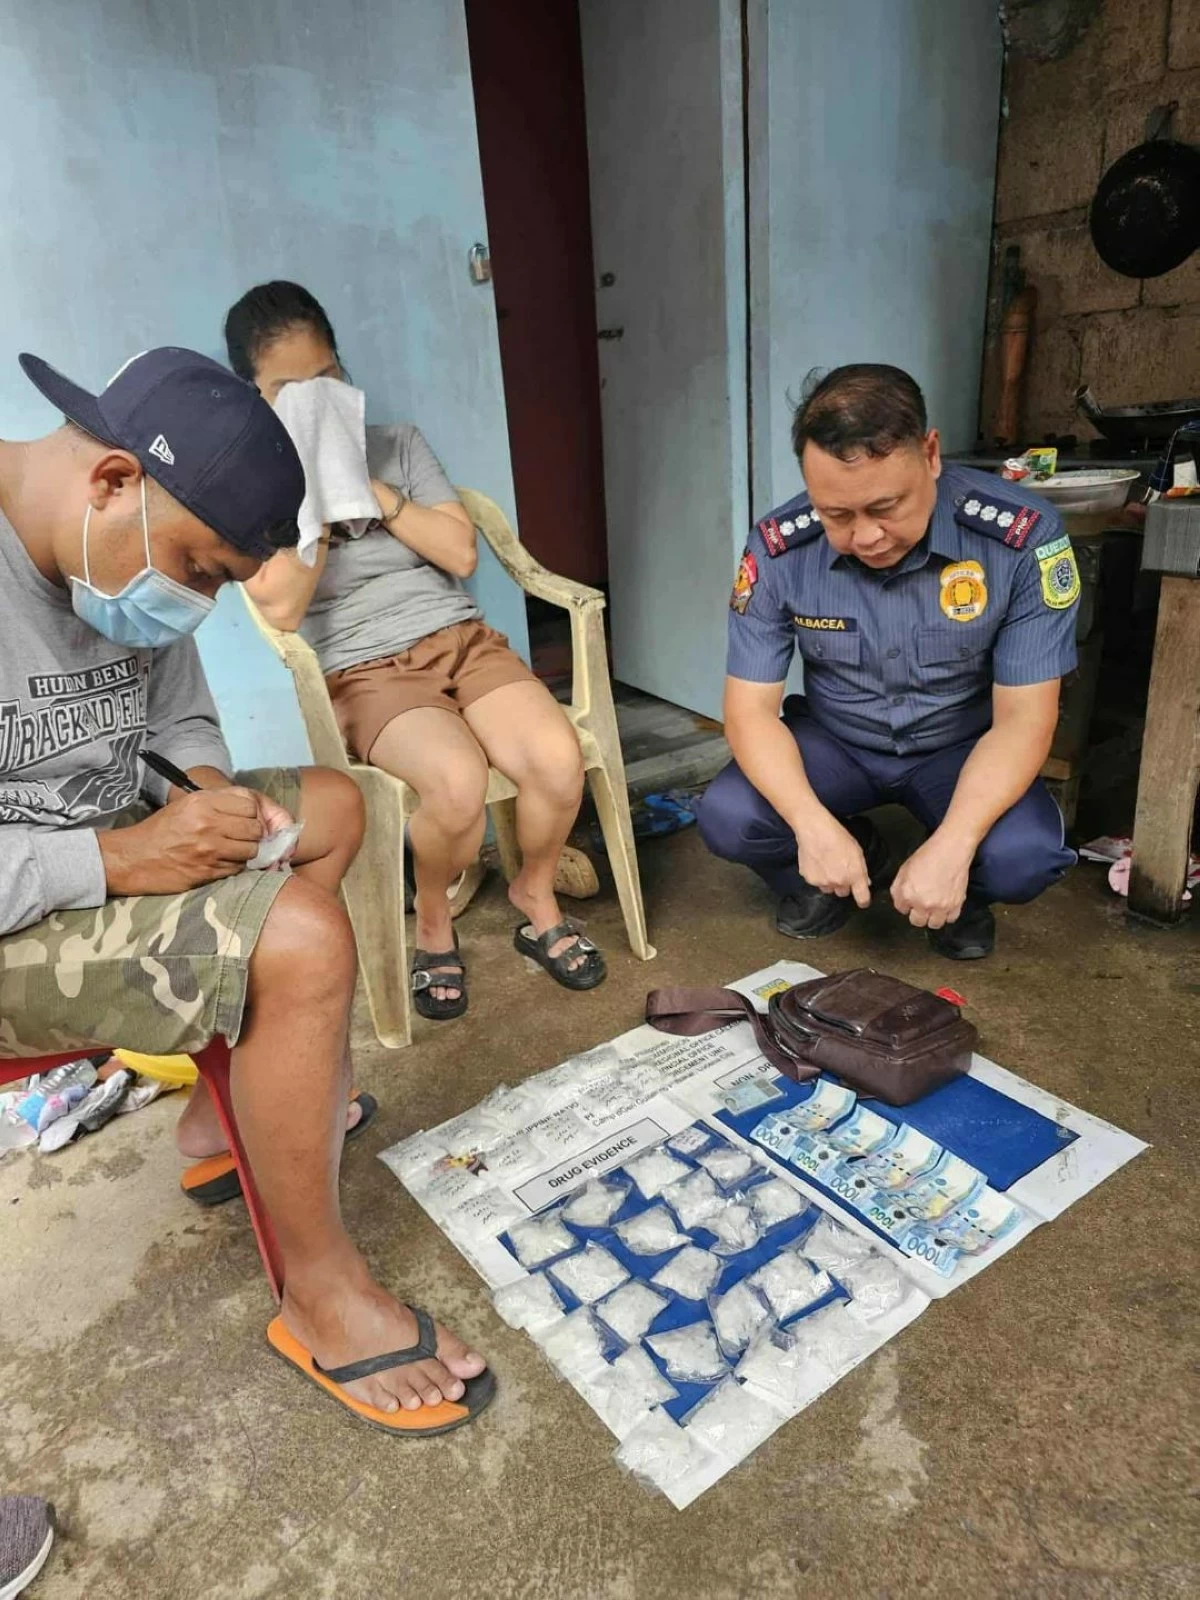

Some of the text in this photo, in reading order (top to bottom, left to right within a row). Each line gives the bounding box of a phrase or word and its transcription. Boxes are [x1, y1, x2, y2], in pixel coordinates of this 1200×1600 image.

[91, 658, 138, 687] BEND
[755, 1127, 782, 1149] 1000
[548, 1166, 583, 1189] DRUG
[582, 1135, 638, 1170] EVIDENCE
[796, 1152, 820, 1172] 1000
[830, 1176, 860, 1201] 1000
[869, 1206, 896, 1230] 1000
[907, 1236, 940, 1266] 1000
